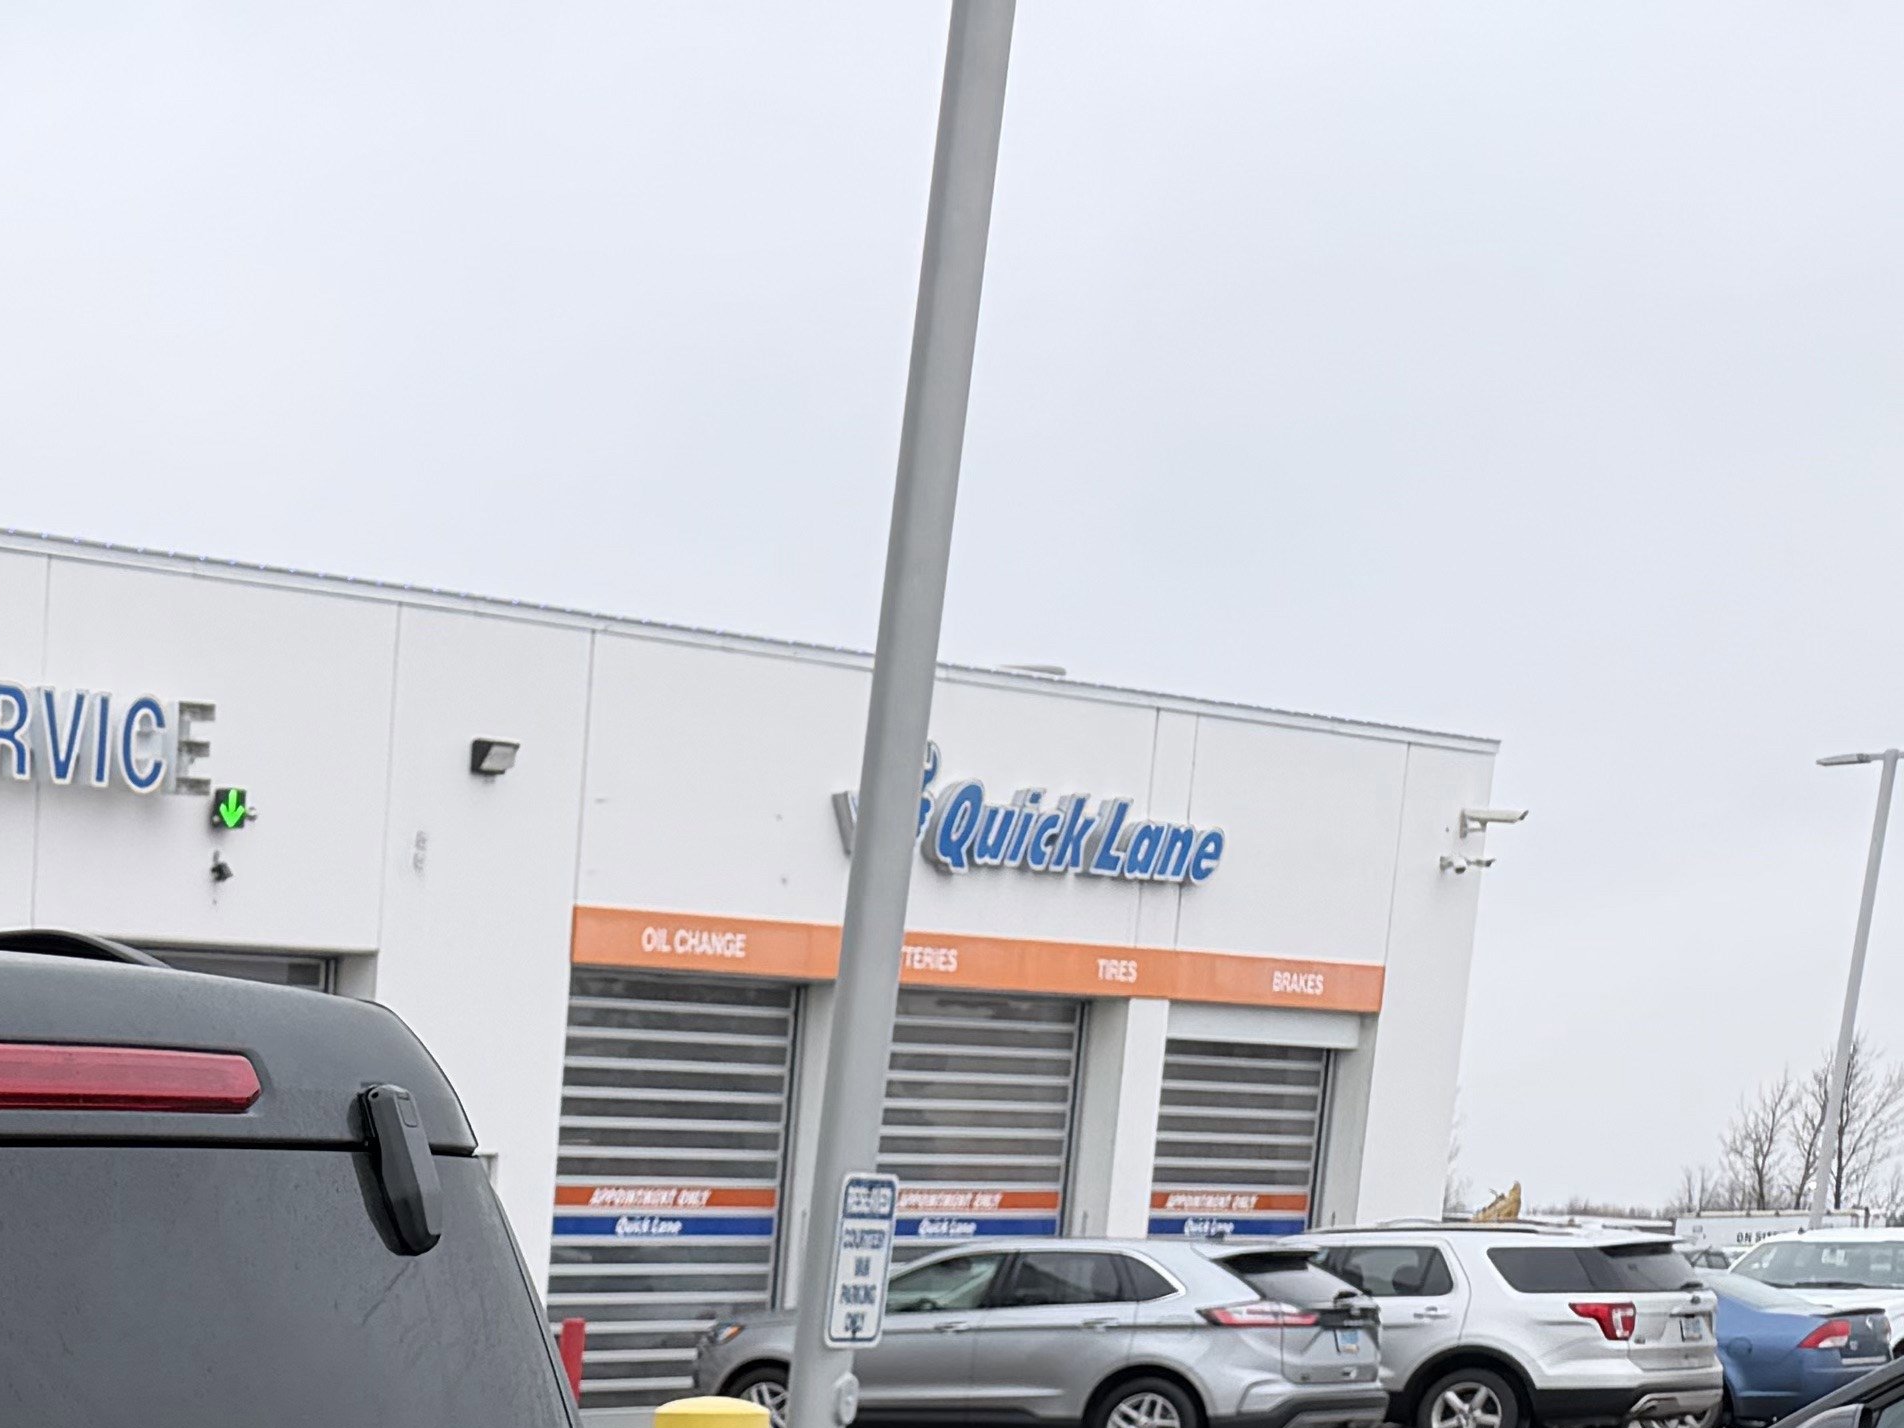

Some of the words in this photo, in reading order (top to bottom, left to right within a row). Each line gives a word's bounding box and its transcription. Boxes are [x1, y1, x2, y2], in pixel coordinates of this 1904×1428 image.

[933, 777, 1097, 874] Quick
[1093, 795, 1225, 884] Lane
[641, 926, 671, 954] OIL
[673, 928, 747, 958] CHANGE
[1096, 958, 1138, 984] TIRES
[1272, 970, 1324, 995] BRAKES
